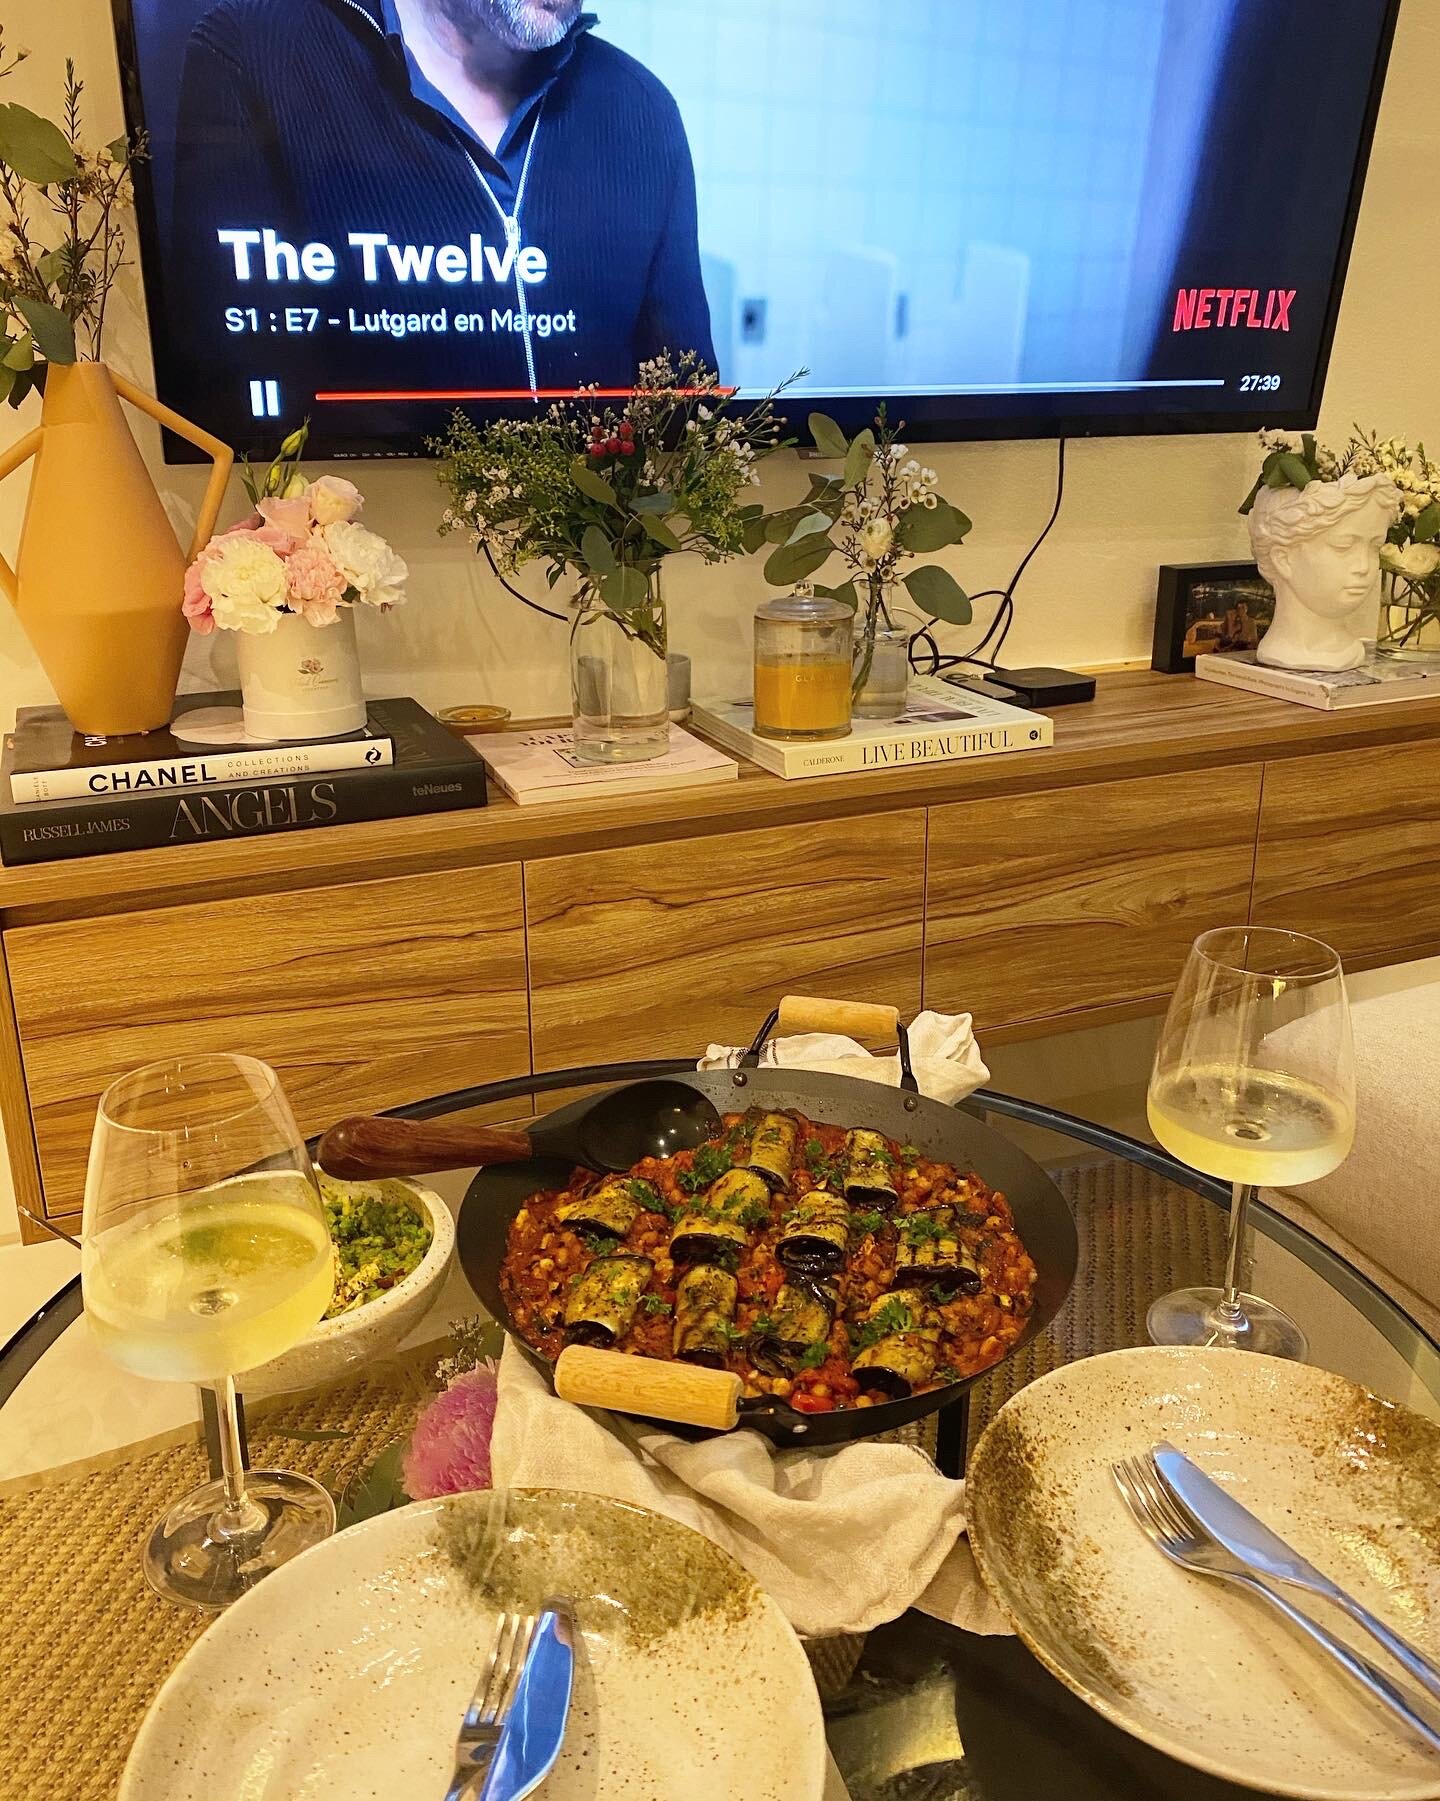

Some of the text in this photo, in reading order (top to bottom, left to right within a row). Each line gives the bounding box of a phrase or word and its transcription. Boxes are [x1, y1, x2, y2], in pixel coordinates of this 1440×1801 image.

[218, 229, 548, 283] The Twelve
[224, 307, 258, 332] S1
[285, 307, 319, 332] E7
[349, 307, 448, 337] Lutgard
[454, 312, 485, 332] en
[490, 309, 576, 337] Margot
[1173, 288, 1296, 332] NETFLIX
[1239, 374, 1281, 392] 27:39
[227, 754, 309, 768] COLLECTIONS
[803, 754, 845, 767] CALDERONE
[863, 743, 905, 765] LIVE
[911, 730, 1013, 759] BEAUTIFUL
[88, 764, 217, 793] CHANEL
[252, 765, 310, 776] CREATIONS
[412, 782, 462, 797] teNeues
[168, 783, 337, 839] ANGELS
[23, 817, 131, 843] RUSSELL JAMES
